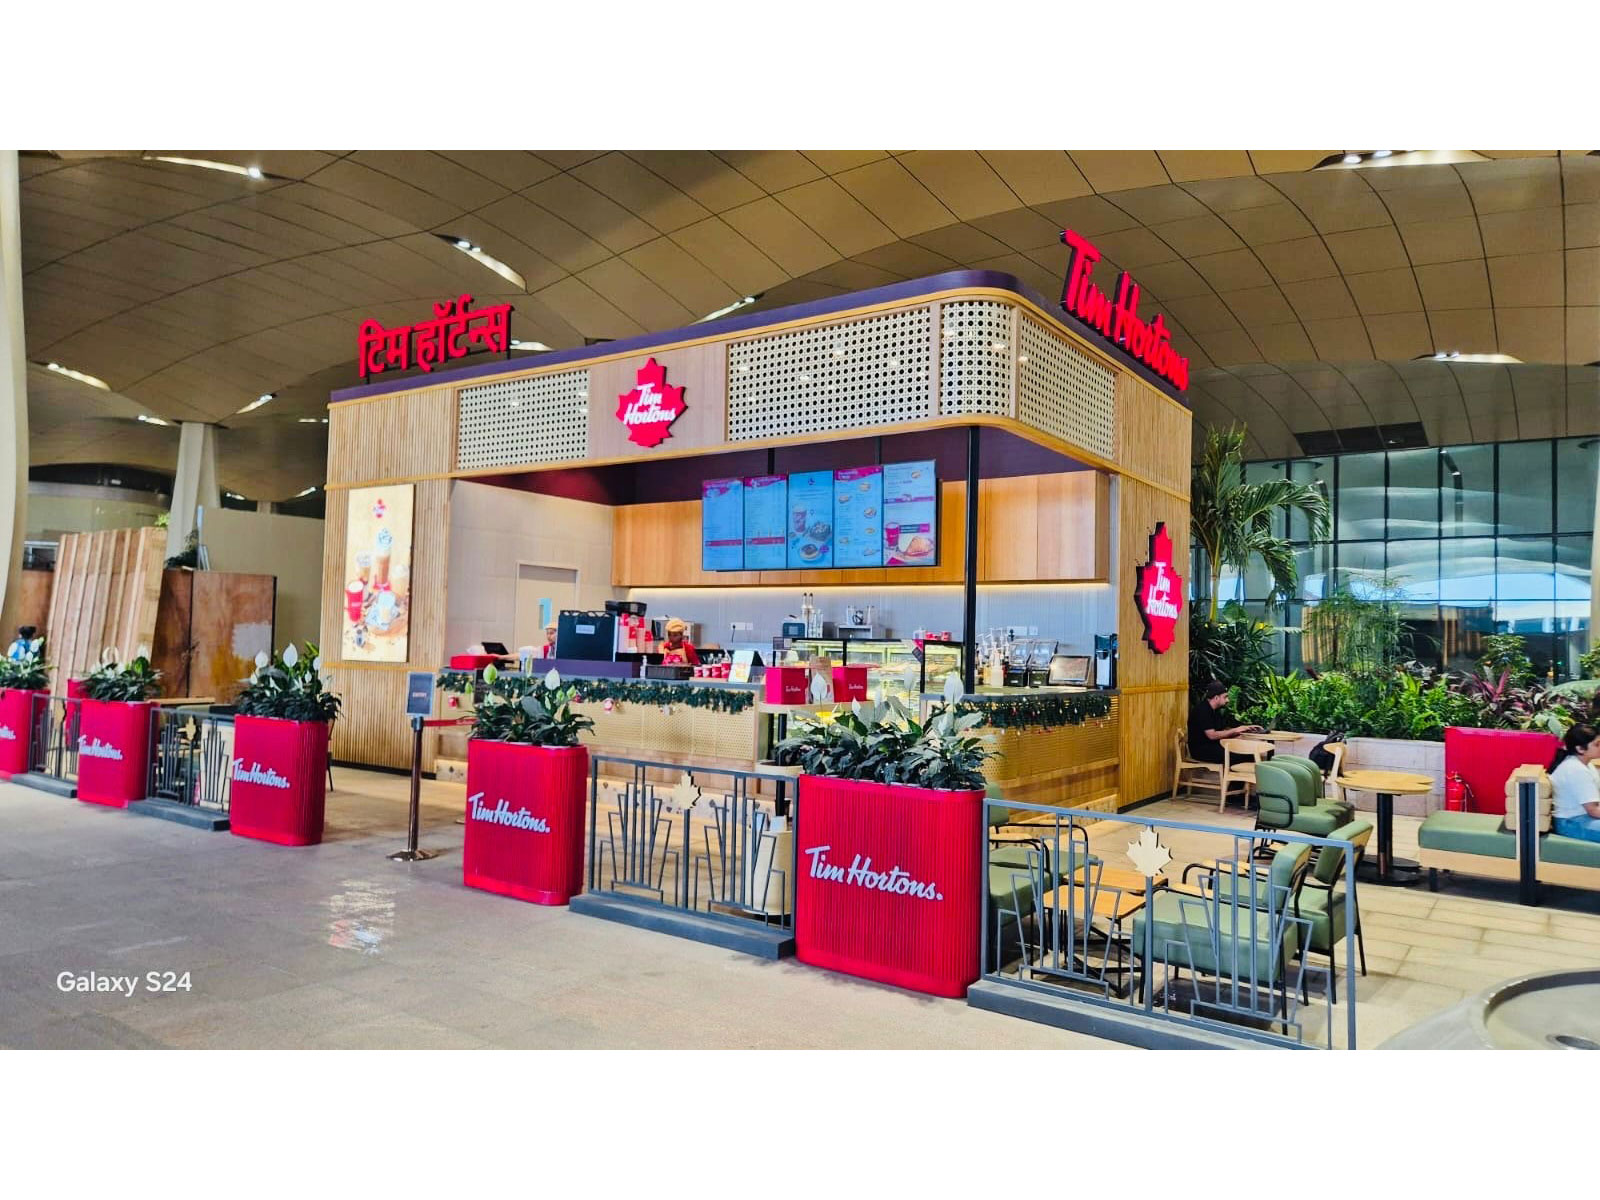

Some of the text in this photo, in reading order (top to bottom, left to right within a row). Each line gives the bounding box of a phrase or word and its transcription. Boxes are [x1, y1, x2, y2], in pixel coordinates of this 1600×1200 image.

[1060, 229, 1190, 391] Tim Hortons
[358, 294, 514, 379] टिम हॉर्टन्स
[637, 382, 663, 406] Tim
[623, 403, 677, 425] Hortons
[1154, 561, 1171, 593] Tim
[233, 757, 251, 783] Tim
[468, 791, 494, 823] Tim
[804, 845, 944, 901] Tim Hortons.
